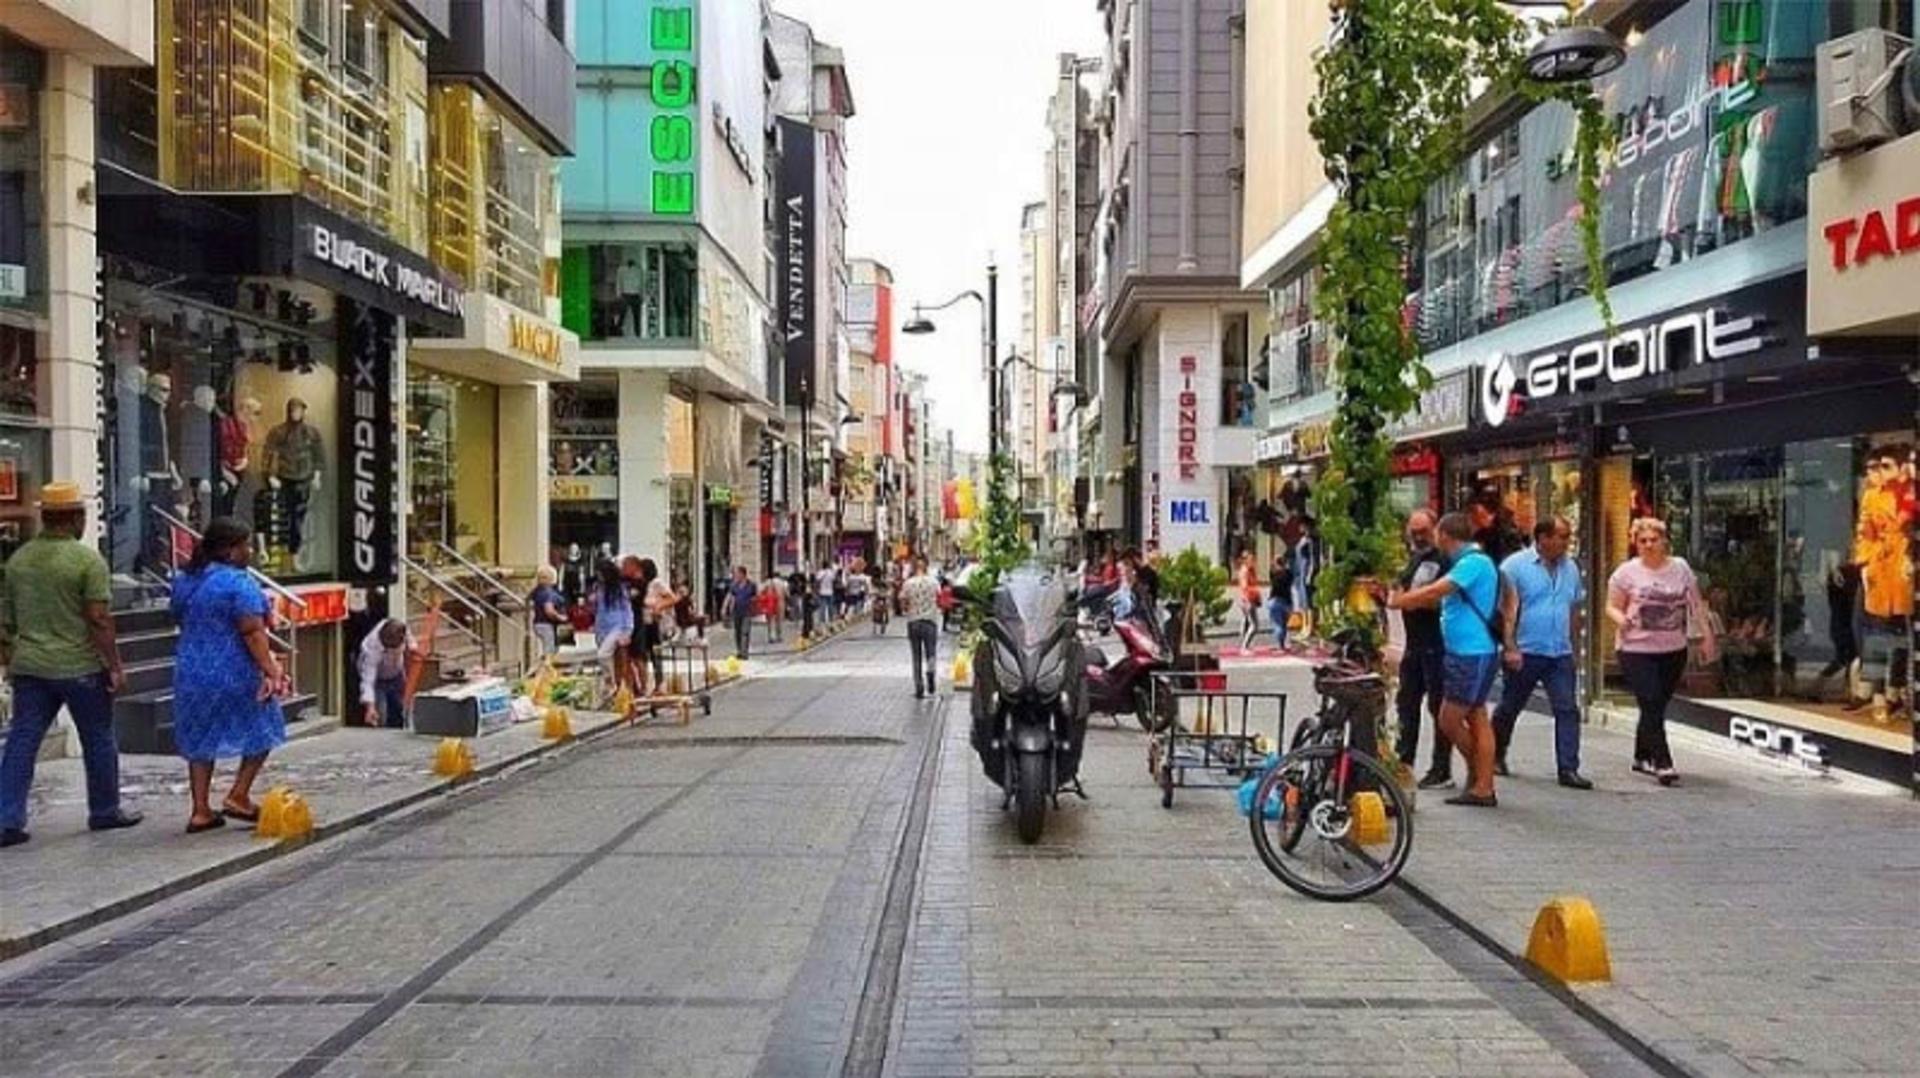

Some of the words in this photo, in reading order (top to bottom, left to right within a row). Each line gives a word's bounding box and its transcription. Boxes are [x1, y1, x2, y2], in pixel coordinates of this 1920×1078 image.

[651, 6, 693, 214] ESCE
[313, 224, 390, 288] BLACK
[396, 262, 465, 319] MARLIN
[786, 194, 804, 342] VENDETTA
[354, 356, 376, 574] GRANDEX
[1178, 356, 1199, 481] SIGNORE
[1170, 500, 1210, 524] MCL
